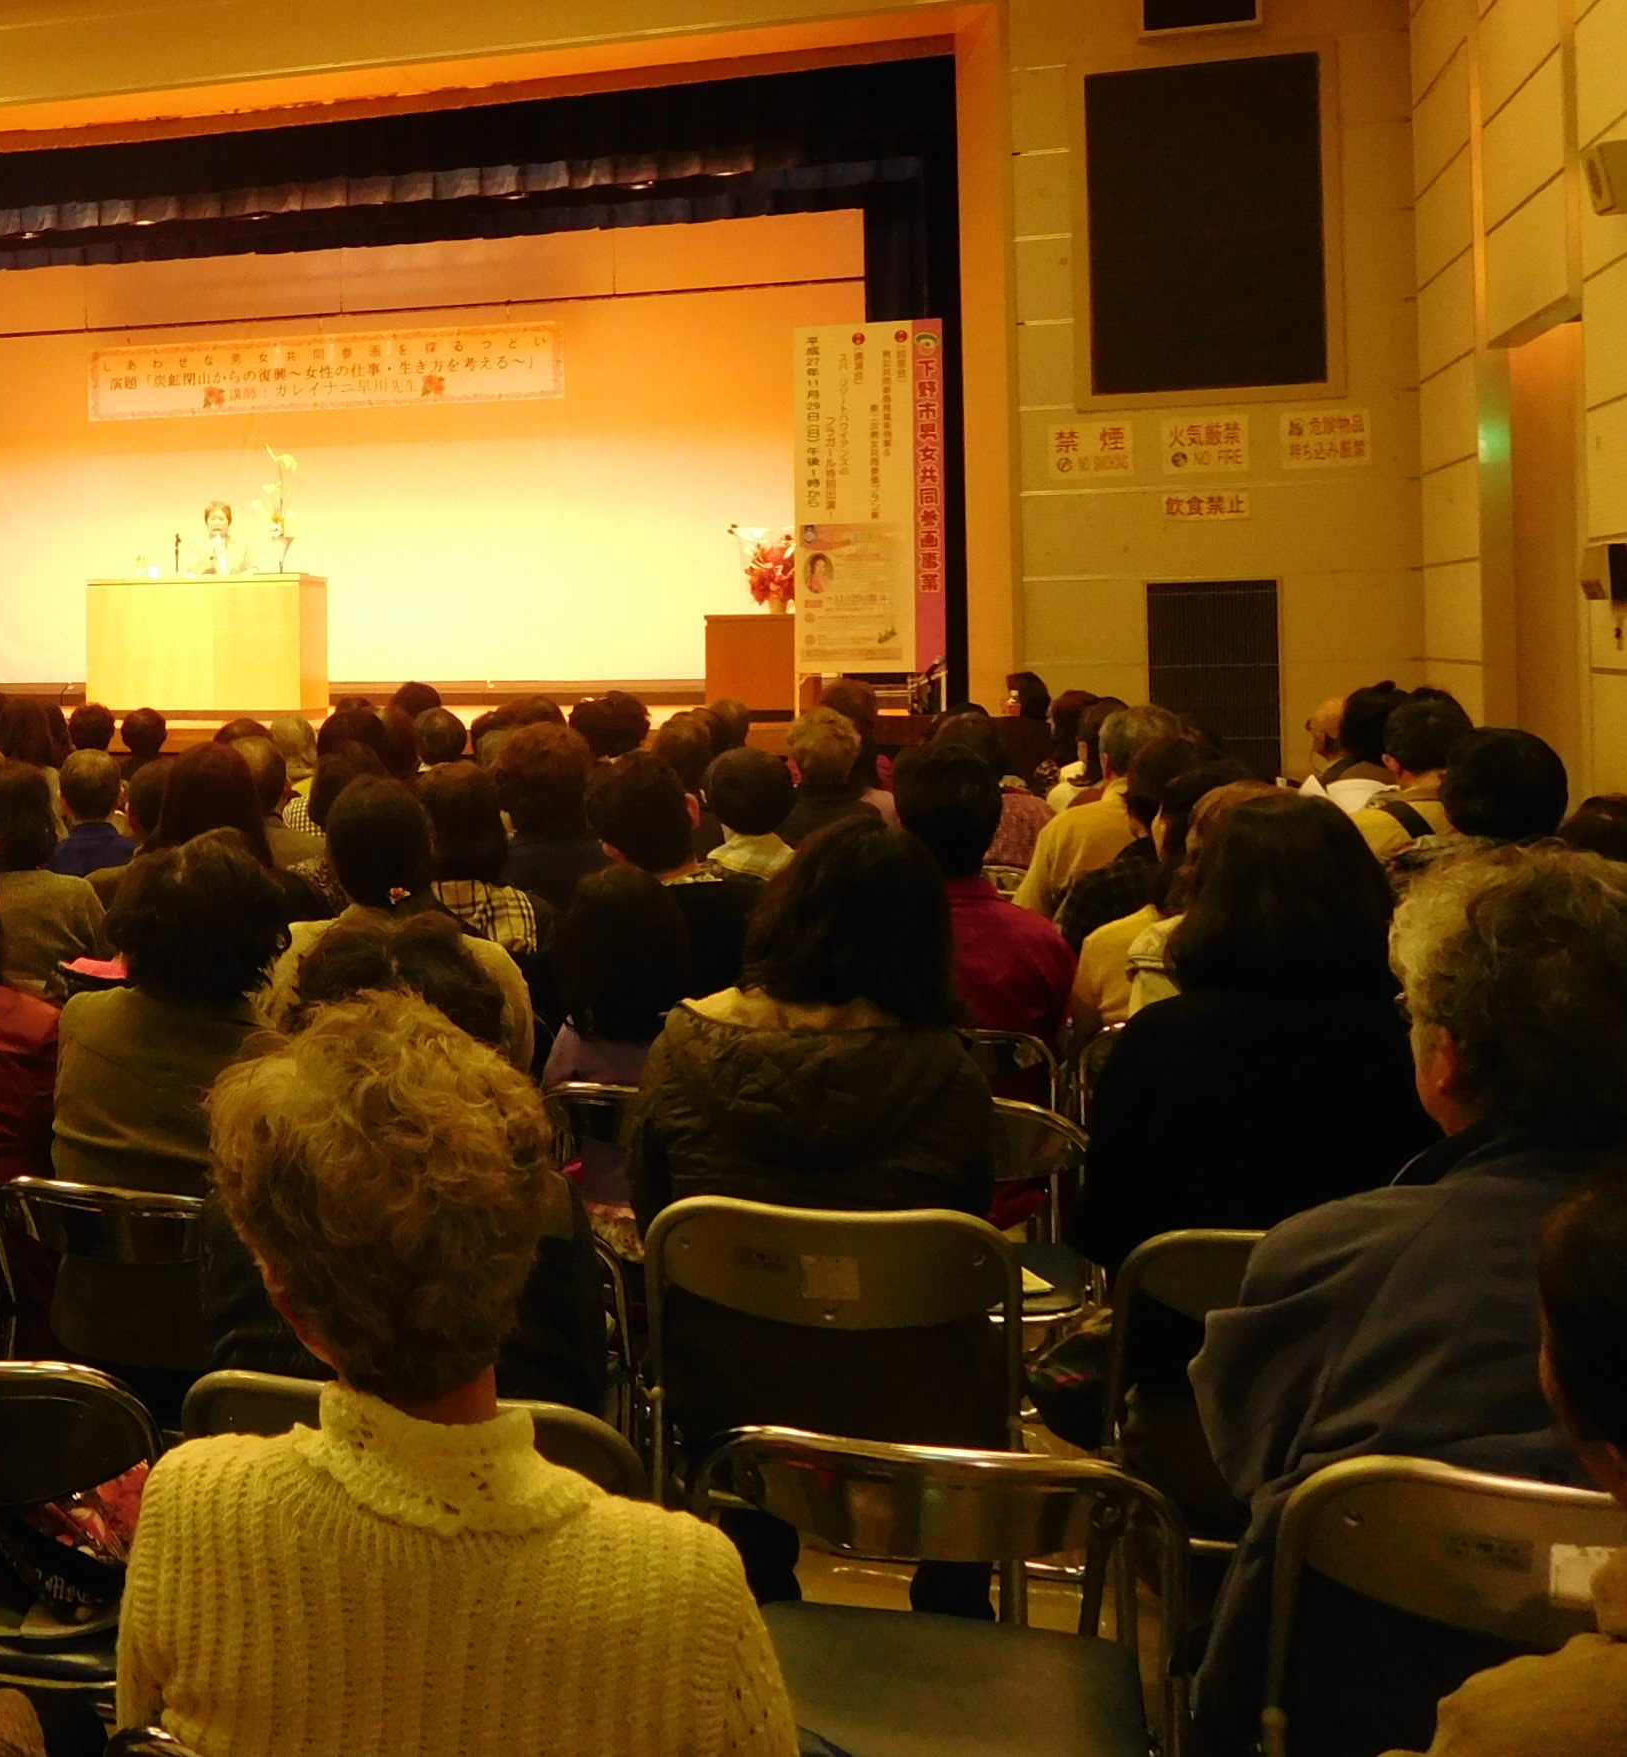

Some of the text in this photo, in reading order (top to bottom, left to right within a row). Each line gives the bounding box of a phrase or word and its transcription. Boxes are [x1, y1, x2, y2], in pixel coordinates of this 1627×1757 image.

[1055, 427, 1125, 453] 禁煙
[1168, 421, 1241, 447] 火気厳禁
[1193, 449, 1243, 466] NO FIRE
[917, 360, 940, 592] 下野市男女共同参画事業
[1165, 495, 1246, 516] 飲食禁止
